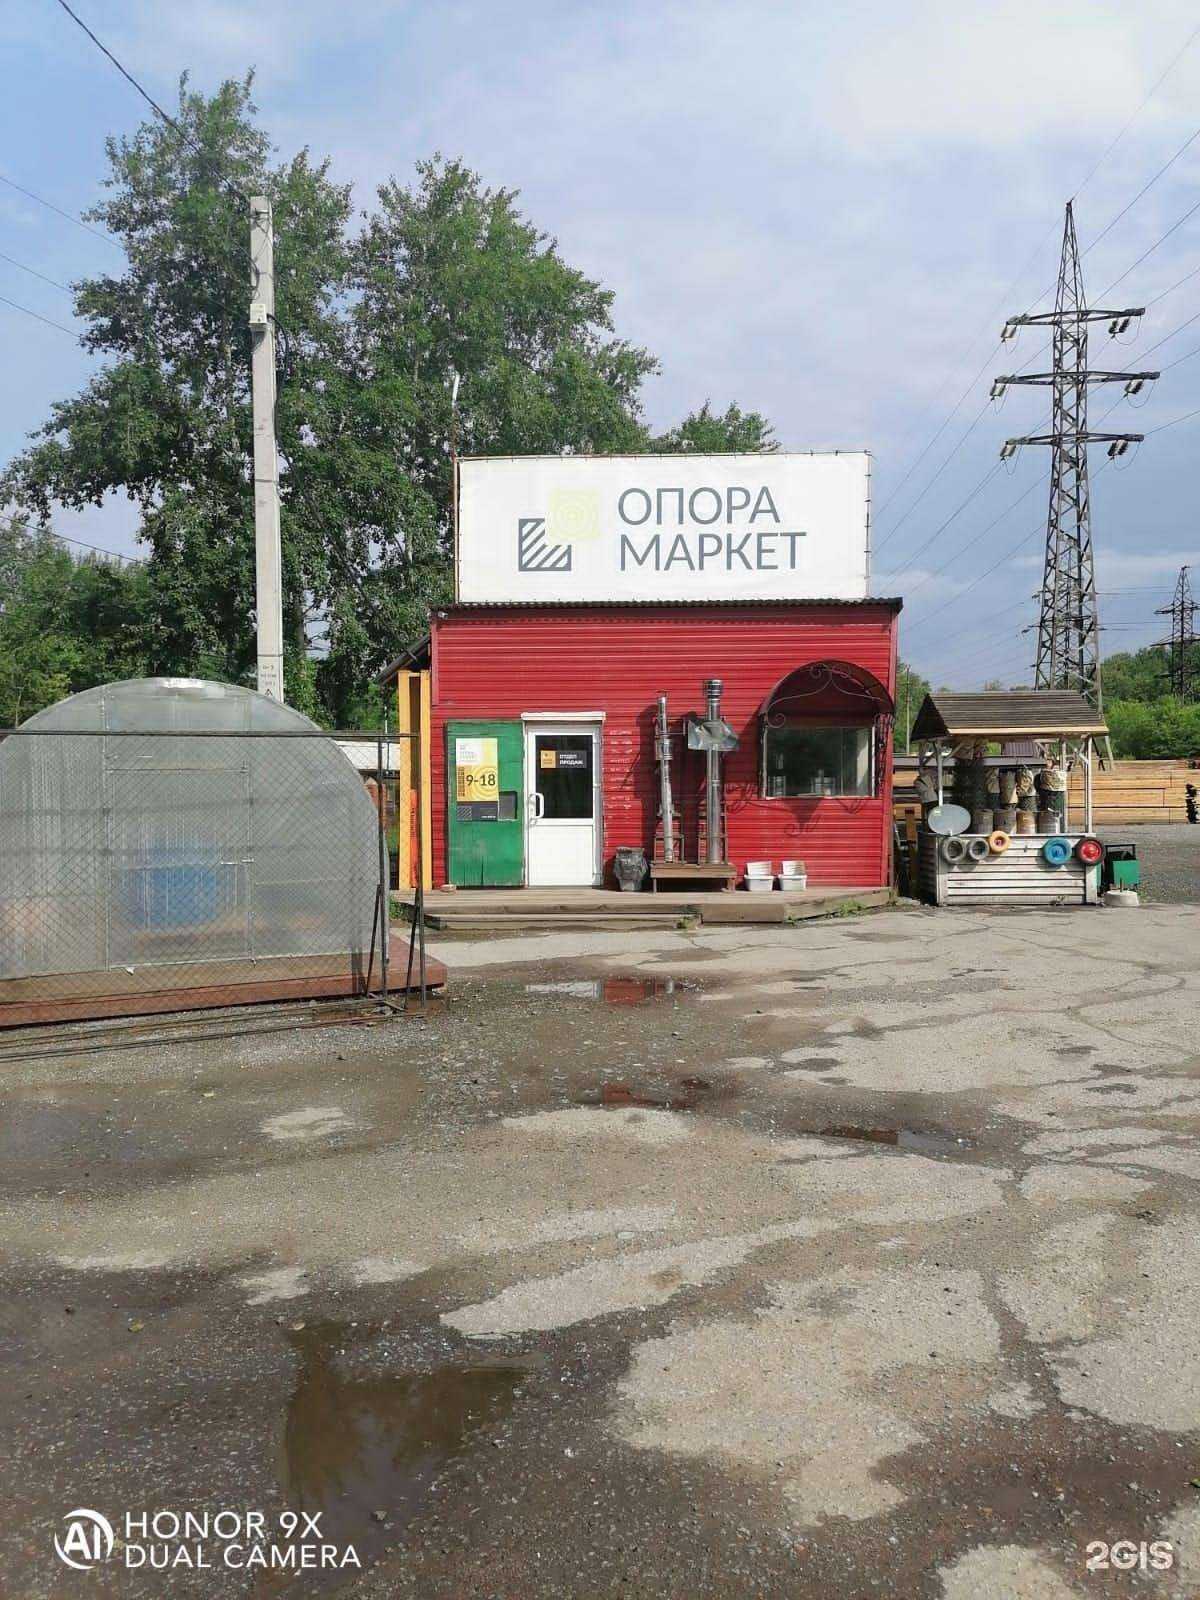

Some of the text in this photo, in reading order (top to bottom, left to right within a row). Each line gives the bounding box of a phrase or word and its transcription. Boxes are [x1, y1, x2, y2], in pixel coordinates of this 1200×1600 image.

[618, 486, 781, 526] ОПОРА
[620, 532, 808, 572] МАРКЕТ
[466, 774, 496, 786] 9-18
